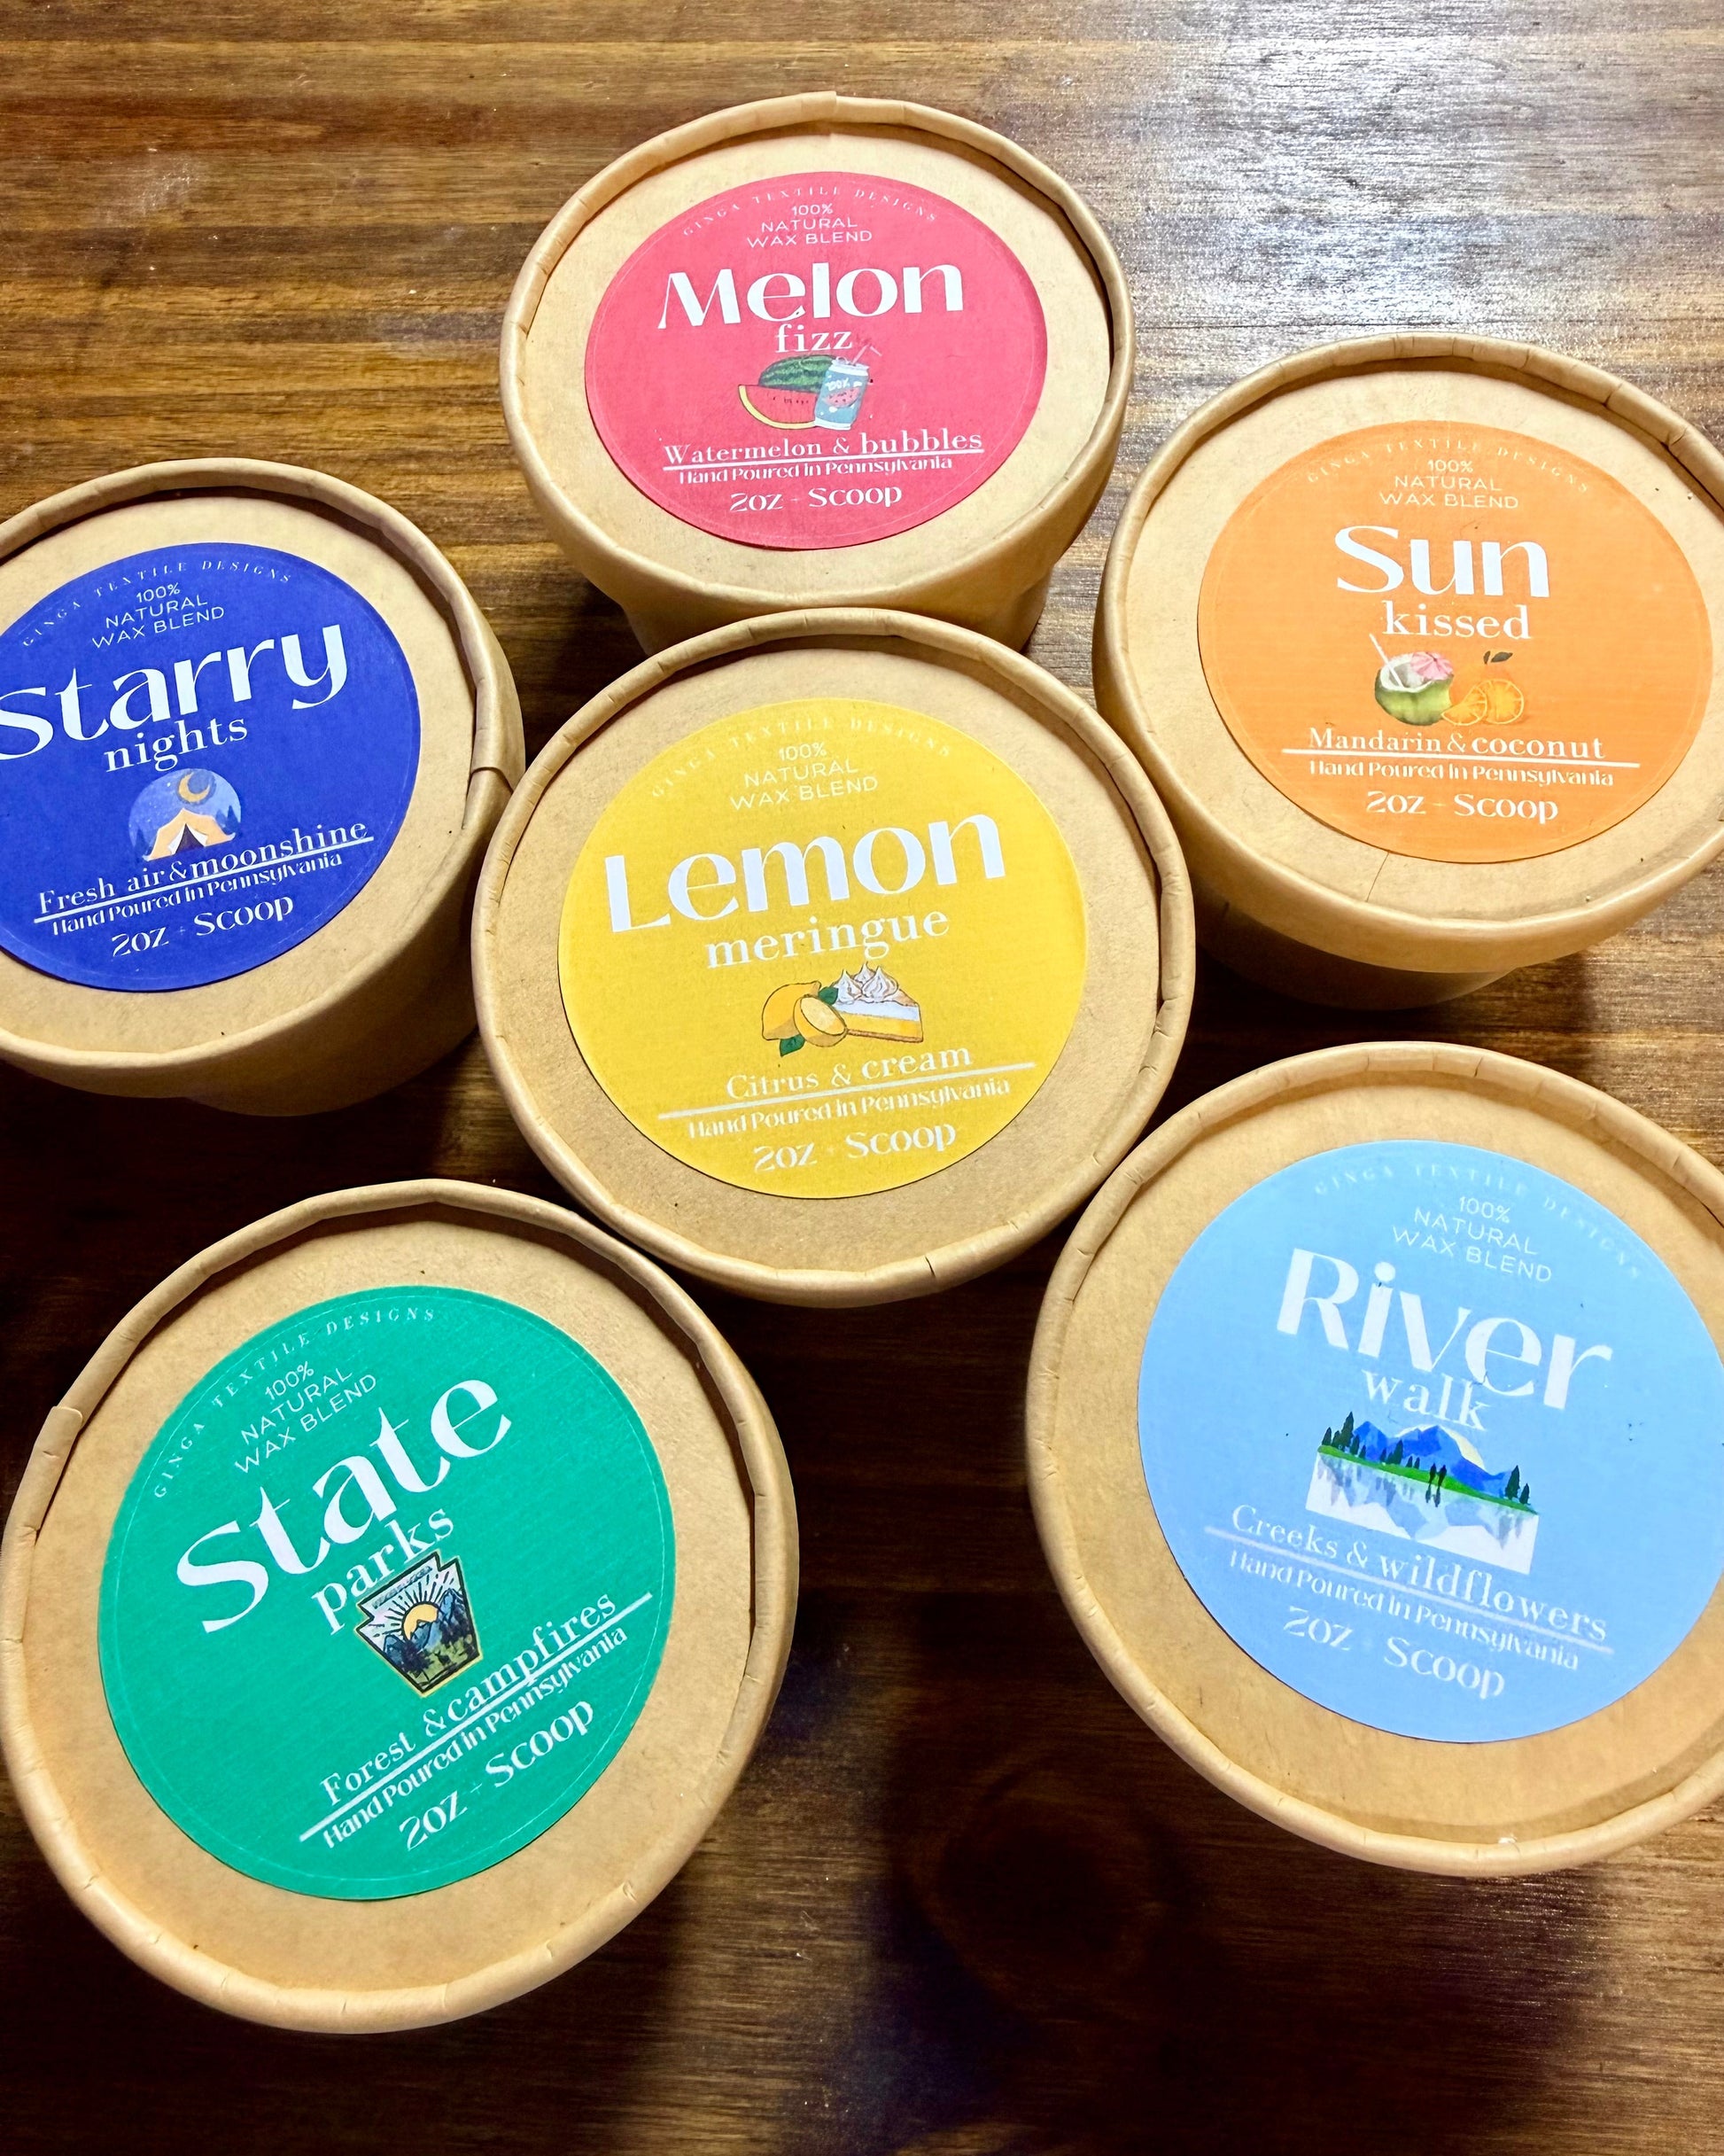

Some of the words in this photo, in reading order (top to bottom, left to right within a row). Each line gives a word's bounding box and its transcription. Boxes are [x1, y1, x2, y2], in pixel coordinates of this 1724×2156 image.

[761, 216, 858, 233] NATURAL
[791, 203, 834, 216] 100%
[747, 235, 796, 248] WAX
[805, 230, 873, 245] BLEND
[657, 261, 963, 330] Melon
[775, 323, 853, 354] fizz
[664, 439, 822, 464] Watermelon
[832, 437, 850, 455] &
[860, 428, 983, 455] bubbles
[680, 465, 728, 485] Hand
[732, 462, 800, 481] Poured
[825, 455, 952, 476] Pennsylvania
[1427, 459, 1473, 473] 100%
[808, 486, 902, 508] Scoop
[1379, 492, 1435, 506] WAX
[1445, 494, 1519, 509] BLEND
[1394, 475, 1503, 491] NATURAL
[1333, 525, 1550, 598] Sun
[105, 594, 208, 628] NATURAL
[136, 582, 181, 603] 100%
[92, 625, 145, 649] WAX
[154, 606, 225, 634] BLEND
[1381, 600, 1532, 640] kissed
[0, 624, 349, 760] Starry
[104, 717, 249, 773] nights
[779, 742, 827, 761] 100%
[1309, 727, 1441, 753] Mandarin
[1447, 732, 1466, 752] &
[1472, 736, 1606, 759] coconut
[729, 788, 790, 810] WAX
[799, 776, 878, 801] BLEND
[743, 758, 858, 788] NATURAL
[1309, 760, 1363, 776] Hand
[1369, 760, 1444, 779] Poured
[1472, 765, 1613, 787] Pennsylvania
[1454, 792, 1558, 824] Scoop
[39, 877, 115, 915] Fresh
[128, 868, 165, 892] air
[169, 860, 187, 881] &
[190, 821, 367, 879] moonshine
[604, 813, 1006, 933] Lemon
[51, 912, 107, 936] Hand
[109, 891, 181, 922] Poured
[206, 852, 343, 894] Pennsylvania
[193, 895, 294, 937] Scoop
[705, 910, 950, 969] meringue
[726, 1074, 819, 1100] Citrus
[830, 1063, 852, 1087] &
[861, 1047, 973, 1080] cream
[688, 1114, 747, 1140] Hand
[752, 1103, 832, 1132] Poured
[860, 1078, 1011, 1115] Pennsylvania
[845, 1123, 957, 1159] Scoop
[1414, 1206, 1540, 1256] NATURAL
[1459, 1195, 1510, 1224] 100%
[1392, 1226, 1456, 1257] WAX
[1465, 1246, 1552, 1282] BLEND
[1276, 1246, 1613, 1412] River
[154, 1422, 206, 1498] GINGA
[212, 1332, 310, 1408] TEXTILE
[325, 1306, 434, 1335] DESIGNS
[265, 1360, 315, 1400] 100%
[1361, 1367, 1493, 1432] walk
[235, 1427, 296, 1474] WAX
[299, 1374, 377, 1432] BLEND
[240, 1367, 353, 1445] NATURAL
[175, 1378, 512, 1634] State
[310, 1506, 455, 1636] parks
[1231, 1504, 1339, 1560] Creeks
[1346, 1540, 1369, 1569] &
[1380, 1553, 1608, 1641] wildflowers
[1229, 1550, 1293, 1584] Hand
[1296, 1568, 1386, 1611] Poured
[1414, 1604, 1579, 1671] Pennsylvania
[1383, 1635, 1504, 1700] Scoop
[320, 1732, 416, 1806] Forest
[423, 1708, 447, 1738] &
[447, 1592, 617, 1723] campfires
[322, 1795, 384, 1849] Hand
[385, 1743, 463, 1807] Poured
[485, 1626, 628, 1732] Pennsylvania
[485, 1700, 594, 1788] Scoop
